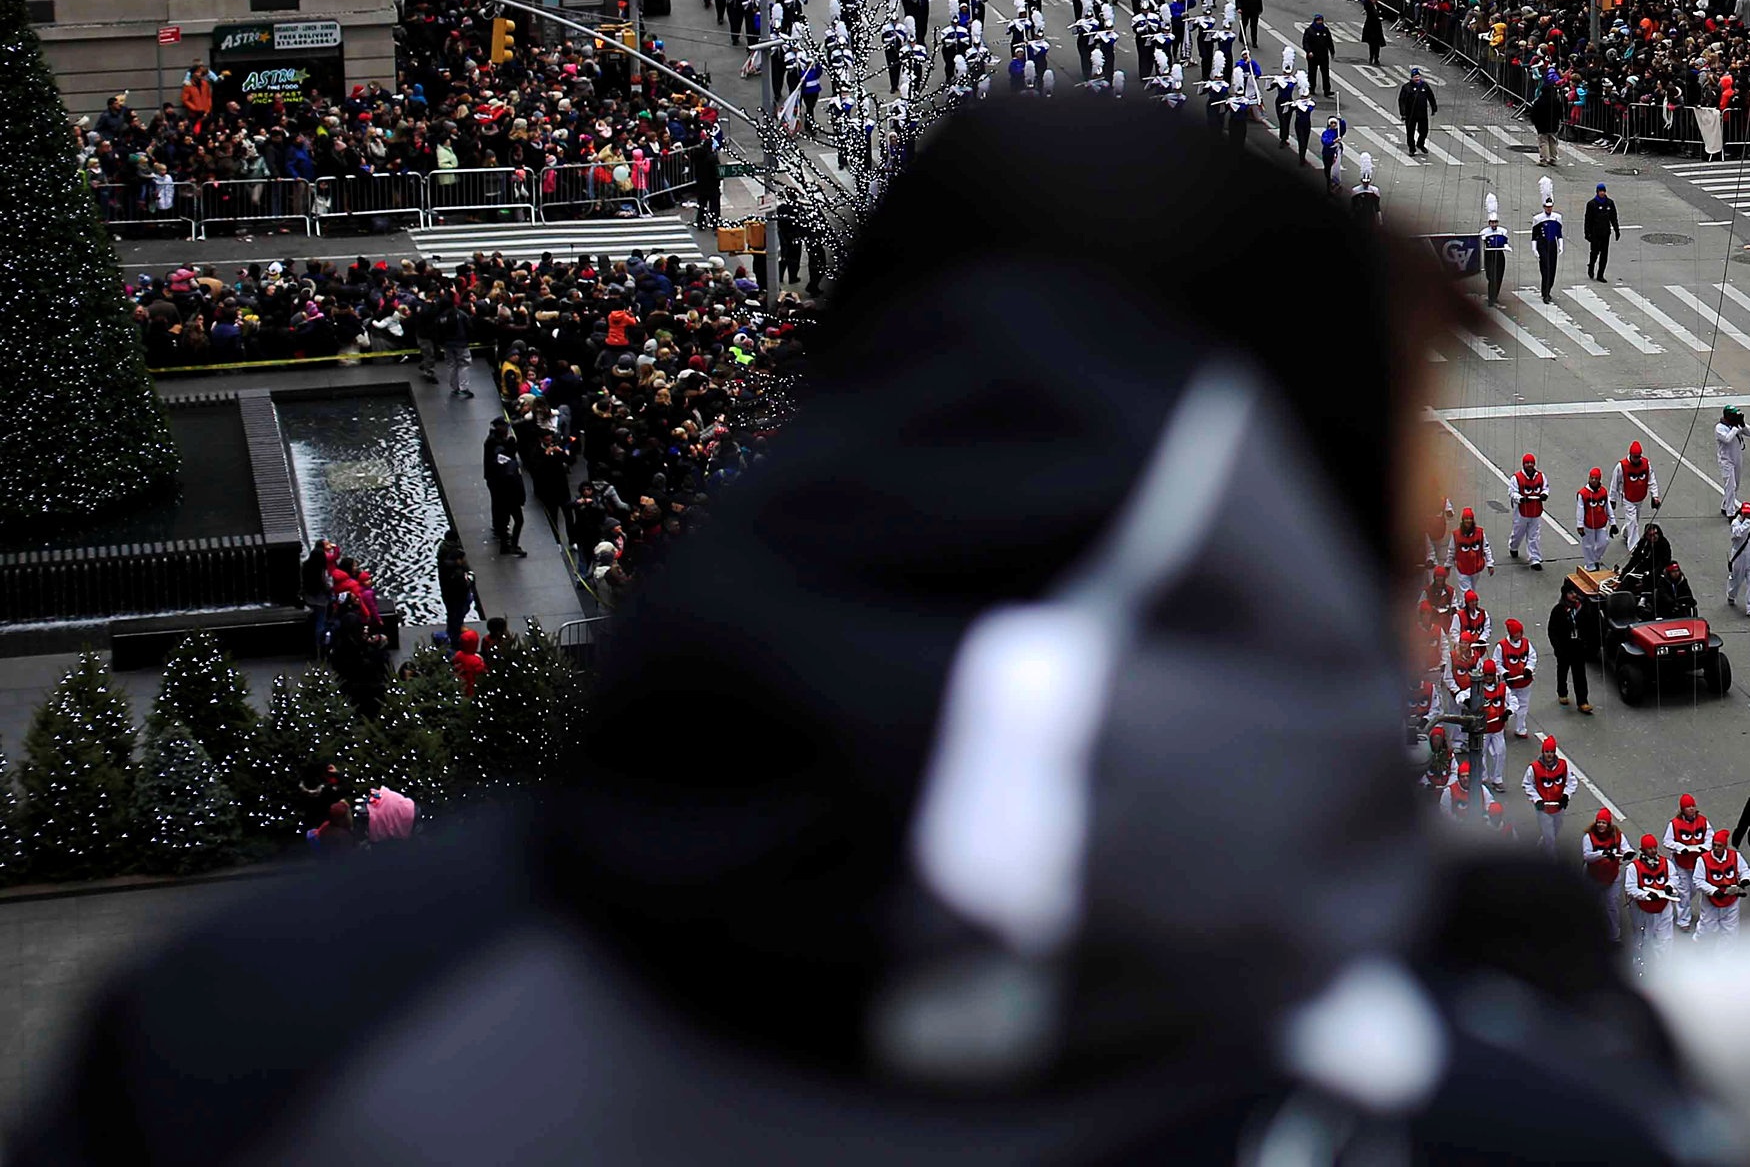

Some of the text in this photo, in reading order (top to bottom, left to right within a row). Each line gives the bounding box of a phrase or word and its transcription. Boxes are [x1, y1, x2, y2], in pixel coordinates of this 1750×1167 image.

[220, 32, 261, 51] ASTRO
[242, 68, 296, 92] ASTRO
[251, 91, 303, 99] BREAFAST
[717, 165, 744, 177] W 55
